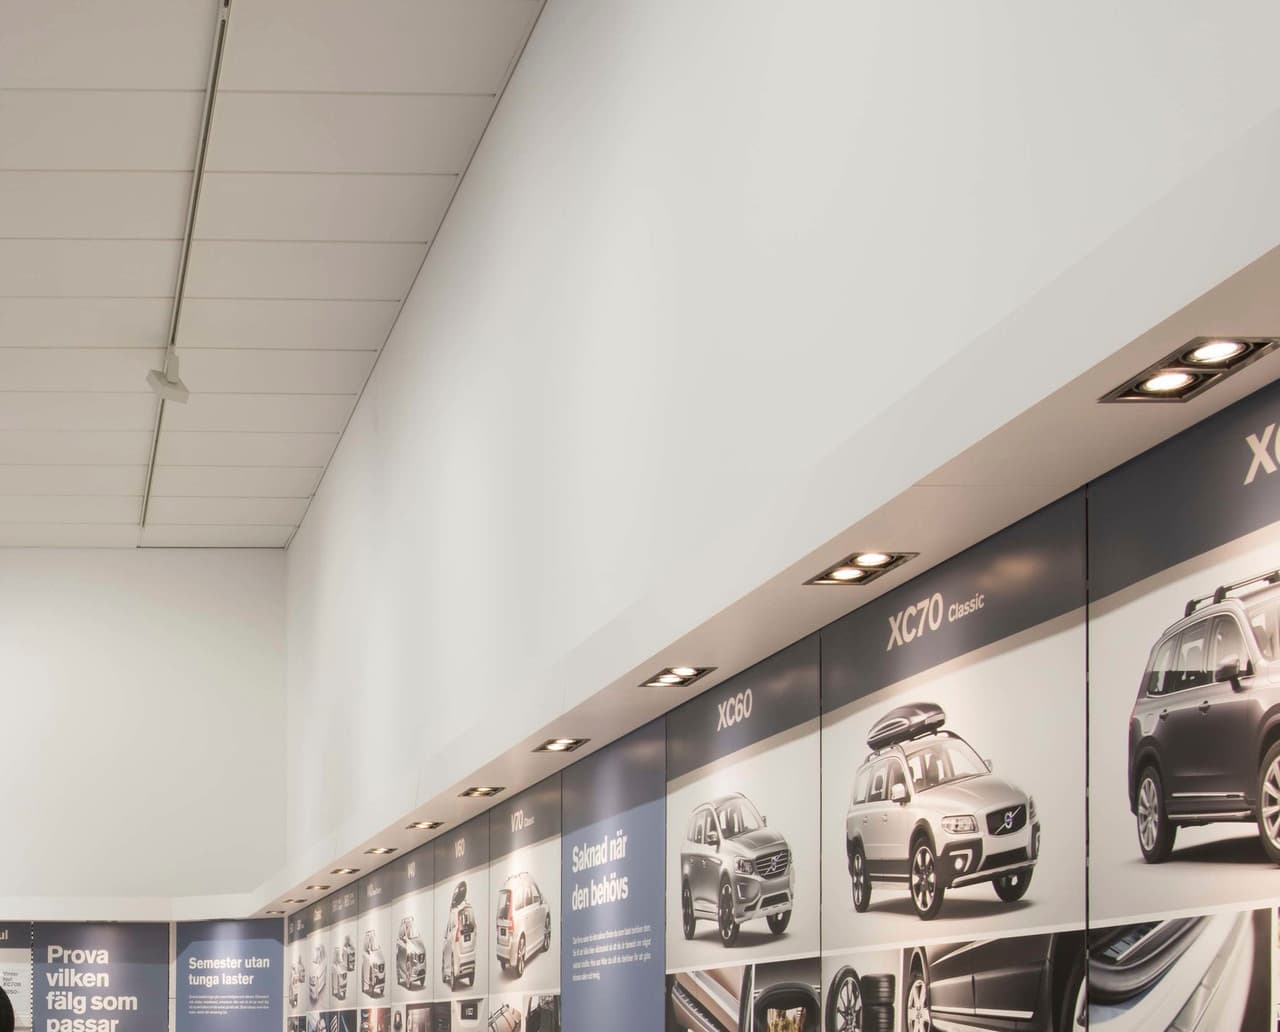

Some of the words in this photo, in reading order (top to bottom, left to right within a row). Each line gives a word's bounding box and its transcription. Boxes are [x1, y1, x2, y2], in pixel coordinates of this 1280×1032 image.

[1243, 423, 1280, 486] X
[886, 592, 945, 651] XC70
[948, 593, 985, 624] Classic
[716, 688, 753, 732] XC60
[510, 808, 524, 833] V70
[571, 837, 609, 873] Saknad
[609, 829, 629, 861] när
[571, 881, 590, 912] den
[589, 873, 629, 908] behövs
[46, 945, 110, 965] Prova
[188, 956, 242, 970] Semester
[244, 956, 271, 969] utan
[46, 968, 110, 988] vilken
[188, 974, 221, 988] tunga
[222, 972, 255, 986] laster
[46, 991, 87, 1014] fälg
[90, 994, 138, 1011] som
